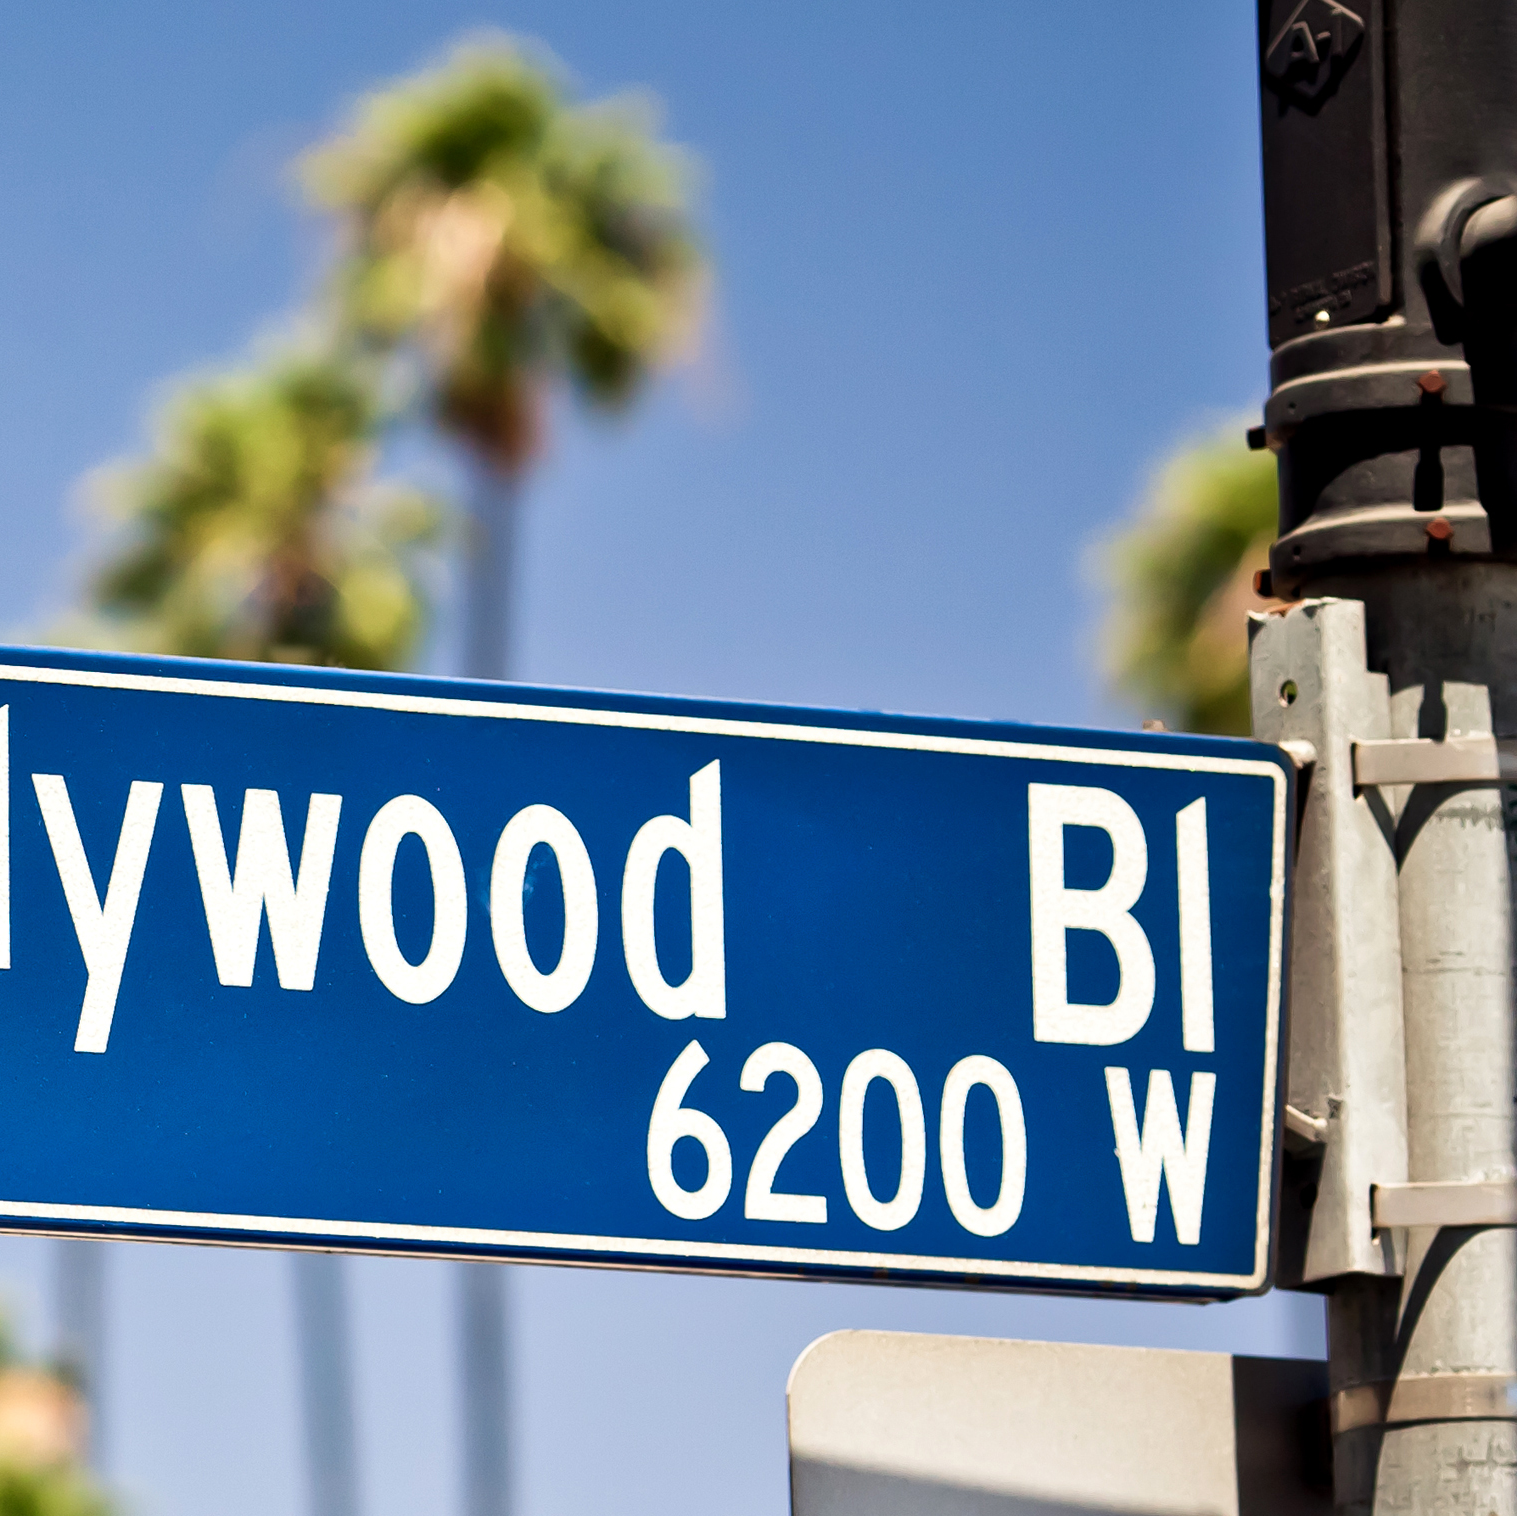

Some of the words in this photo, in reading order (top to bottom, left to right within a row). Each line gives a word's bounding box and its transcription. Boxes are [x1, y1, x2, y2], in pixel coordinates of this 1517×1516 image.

[1027, 782, 1216, 1054] Bl
[646, 1039, 1028, 1238] 6200
[1104, 1066, 1217, 1246] W
